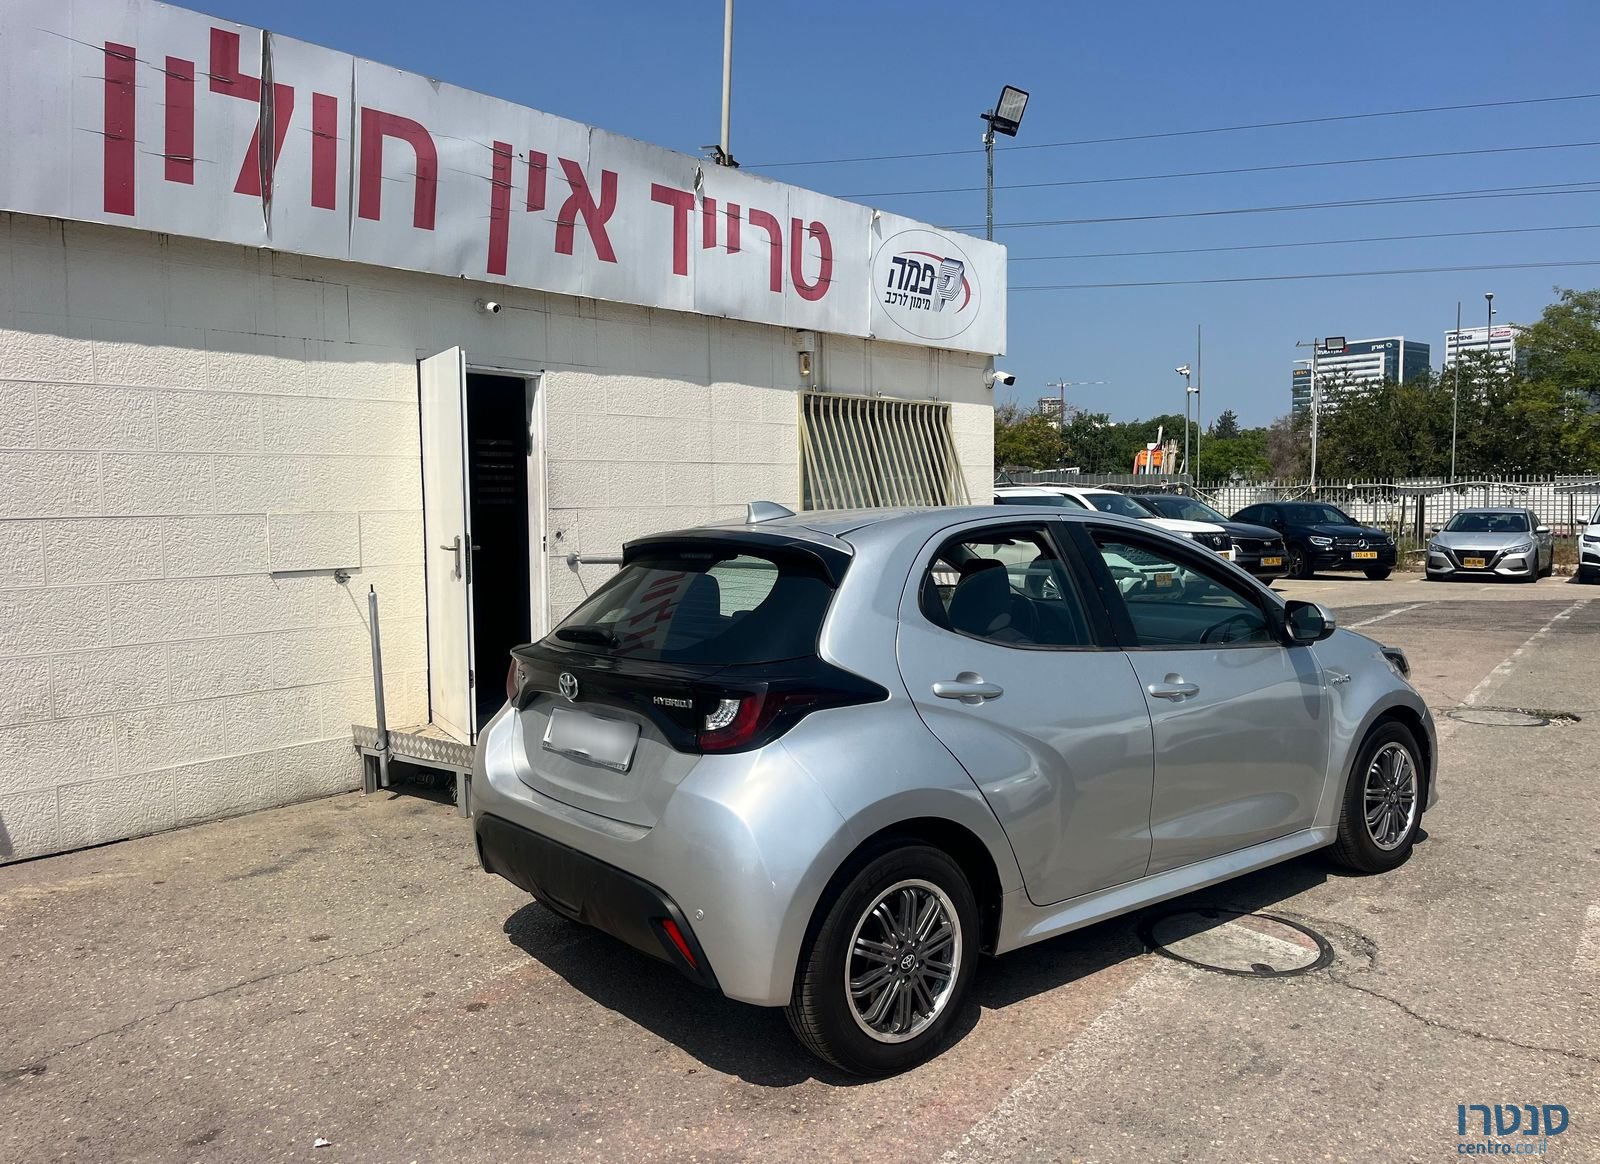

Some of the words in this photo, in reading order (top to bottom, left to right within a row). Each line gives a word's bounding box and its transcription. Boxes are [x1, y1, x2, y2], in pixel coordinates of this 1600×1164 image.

[103, 26, 438, 231] חולון
[486, 140, 618, 276] אין
[650, 182, 833, 302] טרייד
[884, 291, 909, 306] לרכב
[909, 296, 931, 311] מימון
[652, 695, 689, 708] HYBRID
